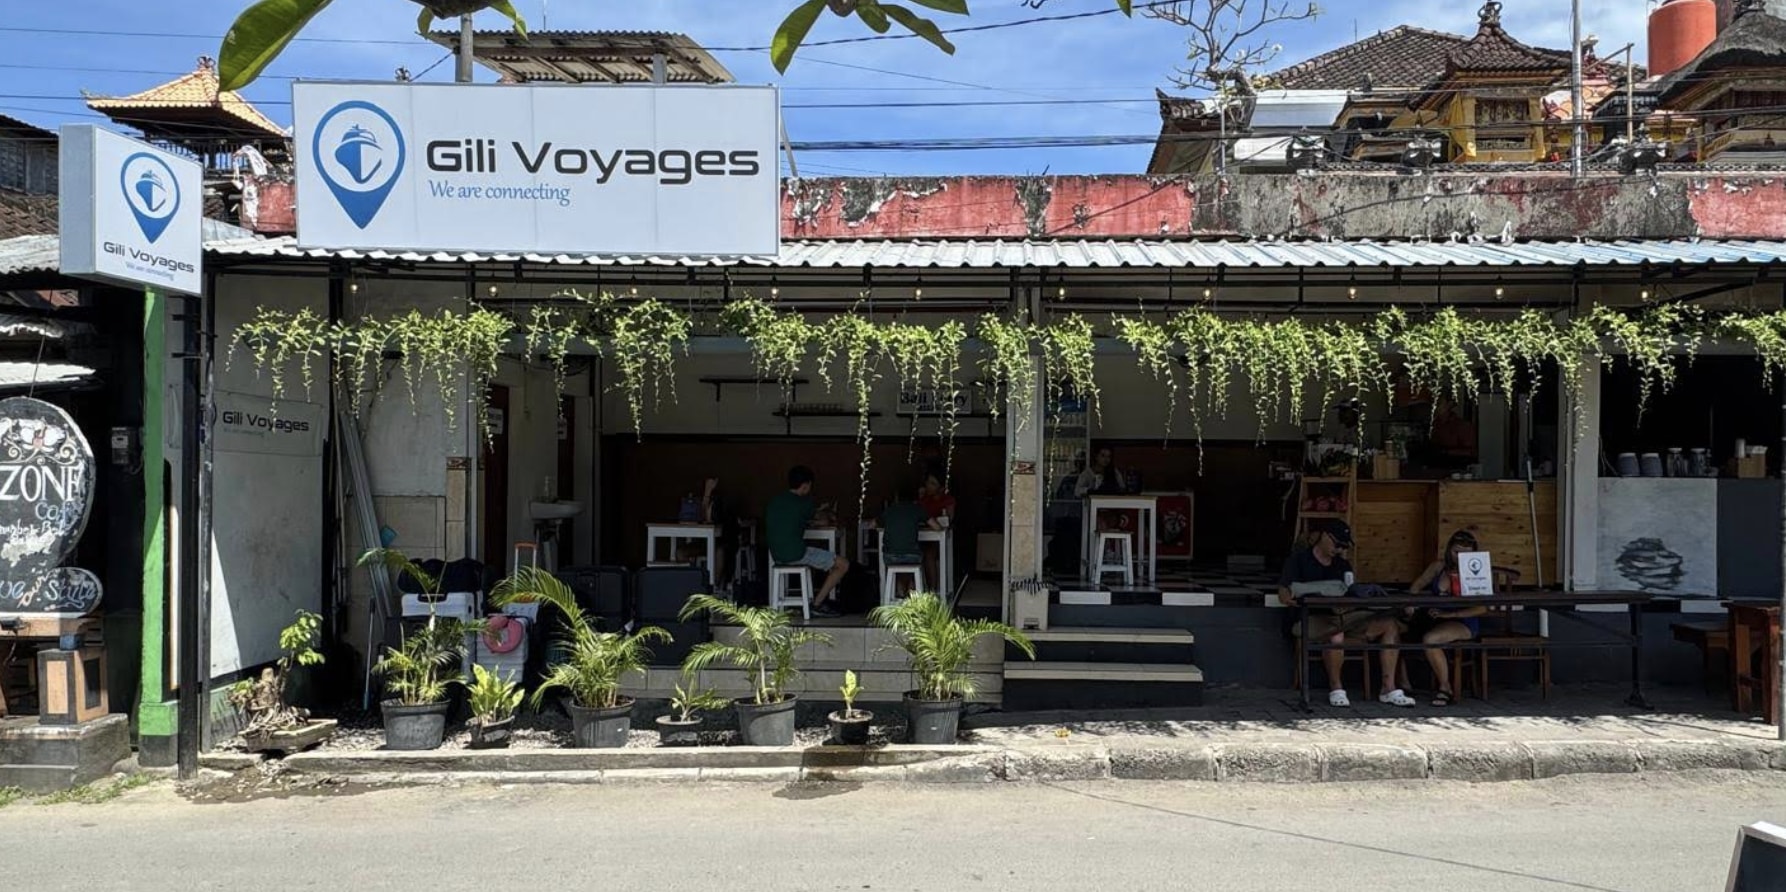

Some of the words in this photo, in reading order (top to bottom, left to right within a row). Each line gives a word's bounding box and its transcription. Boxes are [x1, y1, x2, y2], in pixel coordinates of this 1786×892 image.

[426, 138, 496, 175] Gili
[511, 141, 760, 186] Voyages
[428, 179, 455, 198] We
[457, 186, 483, 199] are
[485, 182, 571, 207] connecting
[103, 241, 126, 257] Gili
[128, 247, 195, 274] Voyages
[223, 411, 243, 425] Gili
[246, 413, 310, 434] Voyages
